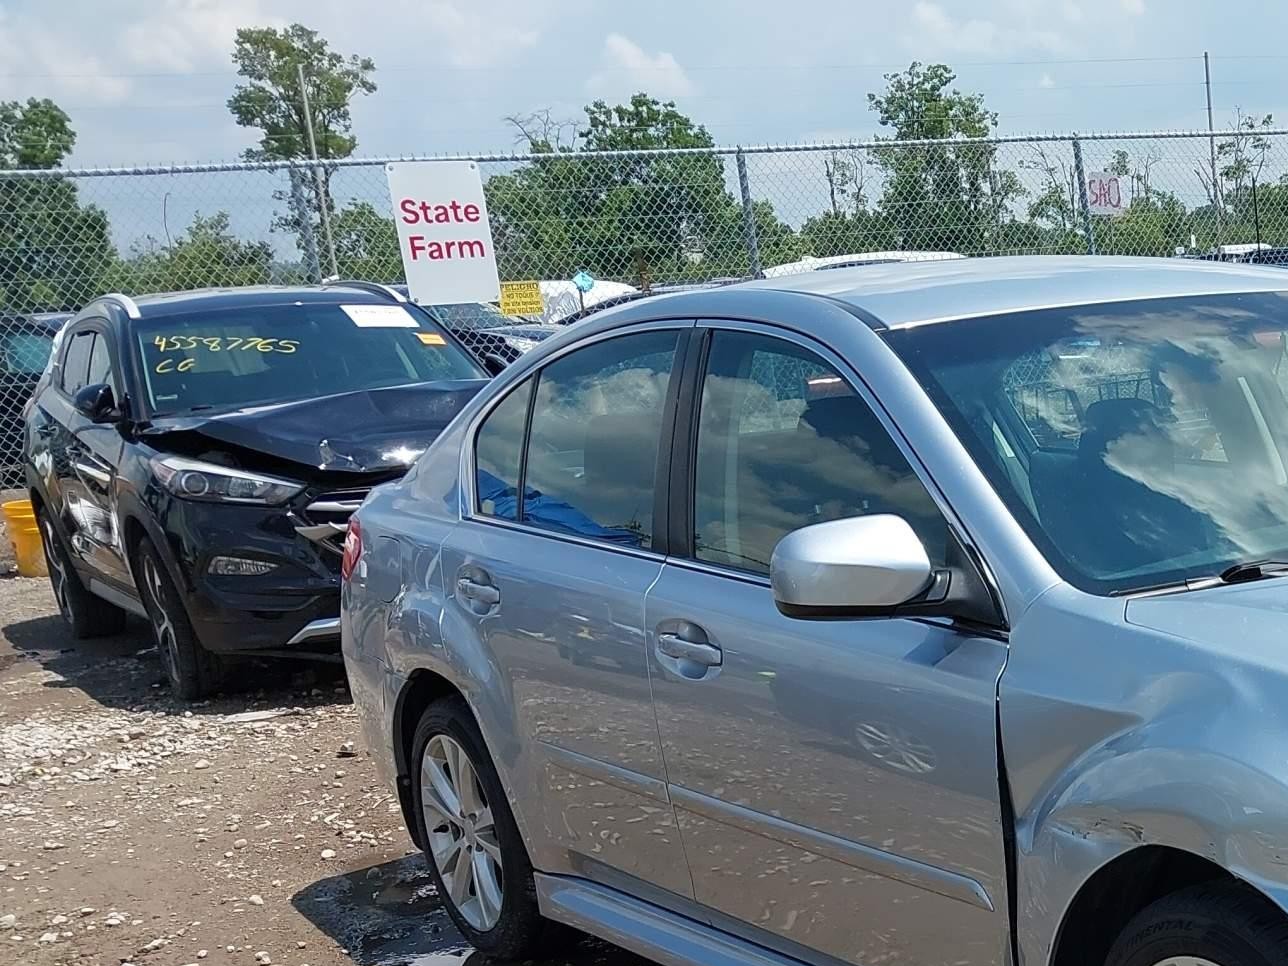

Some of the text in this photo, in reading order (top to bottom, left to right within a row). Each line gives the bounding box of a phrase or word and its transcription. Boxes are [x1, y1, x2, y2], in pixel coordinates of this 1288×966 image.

[400, 199, 480, 224] State
[408, 235, 485, 260] Farm
[154, 335, 301, 354] 45587765
